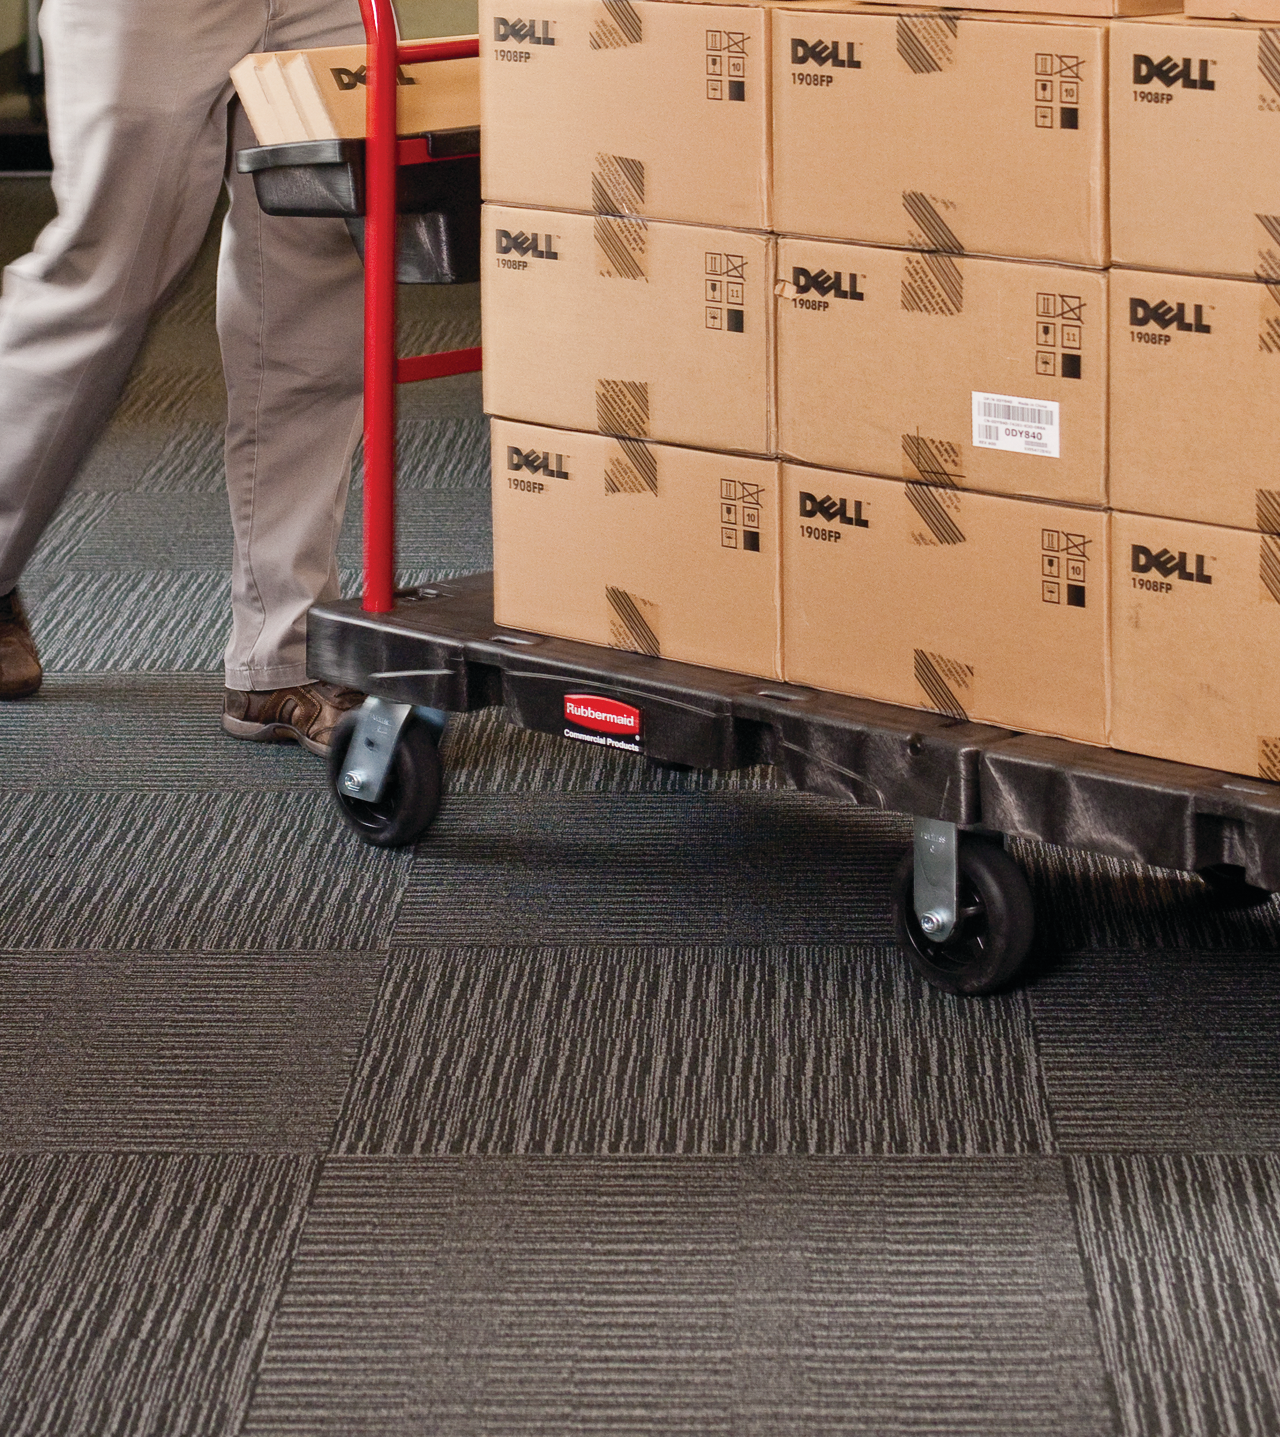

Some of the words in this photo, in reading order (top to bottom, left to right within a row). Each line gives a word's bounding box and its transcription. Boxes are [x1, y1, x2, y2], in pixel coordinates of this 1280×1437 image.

[494, 17, 555, 46] DELL
[494, 49, 531, 63] 1908FP
[791, 38, 862, 69] DELL
[731, 62, 741, 72] 10
[1133, 54, 1215, 91] DELL
[791, 73, 833, 87] 1908FP
[1064, 88, 1074, 98] 10
[1132, 90, 1173, 104] 1908FP
[495, 229, 558, 260] DELL
[496, 258, 528, 271] 1908FP
[792, 266, 864, 301] DELL
[731, 289, 739, 298] 11
[792, 298, 829, 312] 1908FP
[1129, 297, 1211, 334] DELL
[1066, 332, 1076, 342] 11
[1130, 331, 1171, 346] 1908FP
[1005, 427, 1042, 441] 0DY840
[507, 445, 569, 480] DELL
[507, 477, 544, 494] 1908FP
[747, 513, 755, 523] 10
[799, 491, 869, 528] DELL
[800, 525, 841, 543] 1908FP
[1071, 566, 1081, 576] 10
[1131, 544, 1212, 585] DELL
[1131, 577, 1172, 594] 1908FP
[566, 702, 634, 727] Rubbermaid
[564, 728, 605, 745] Commercial
[607, 737, 639, 752] Products
